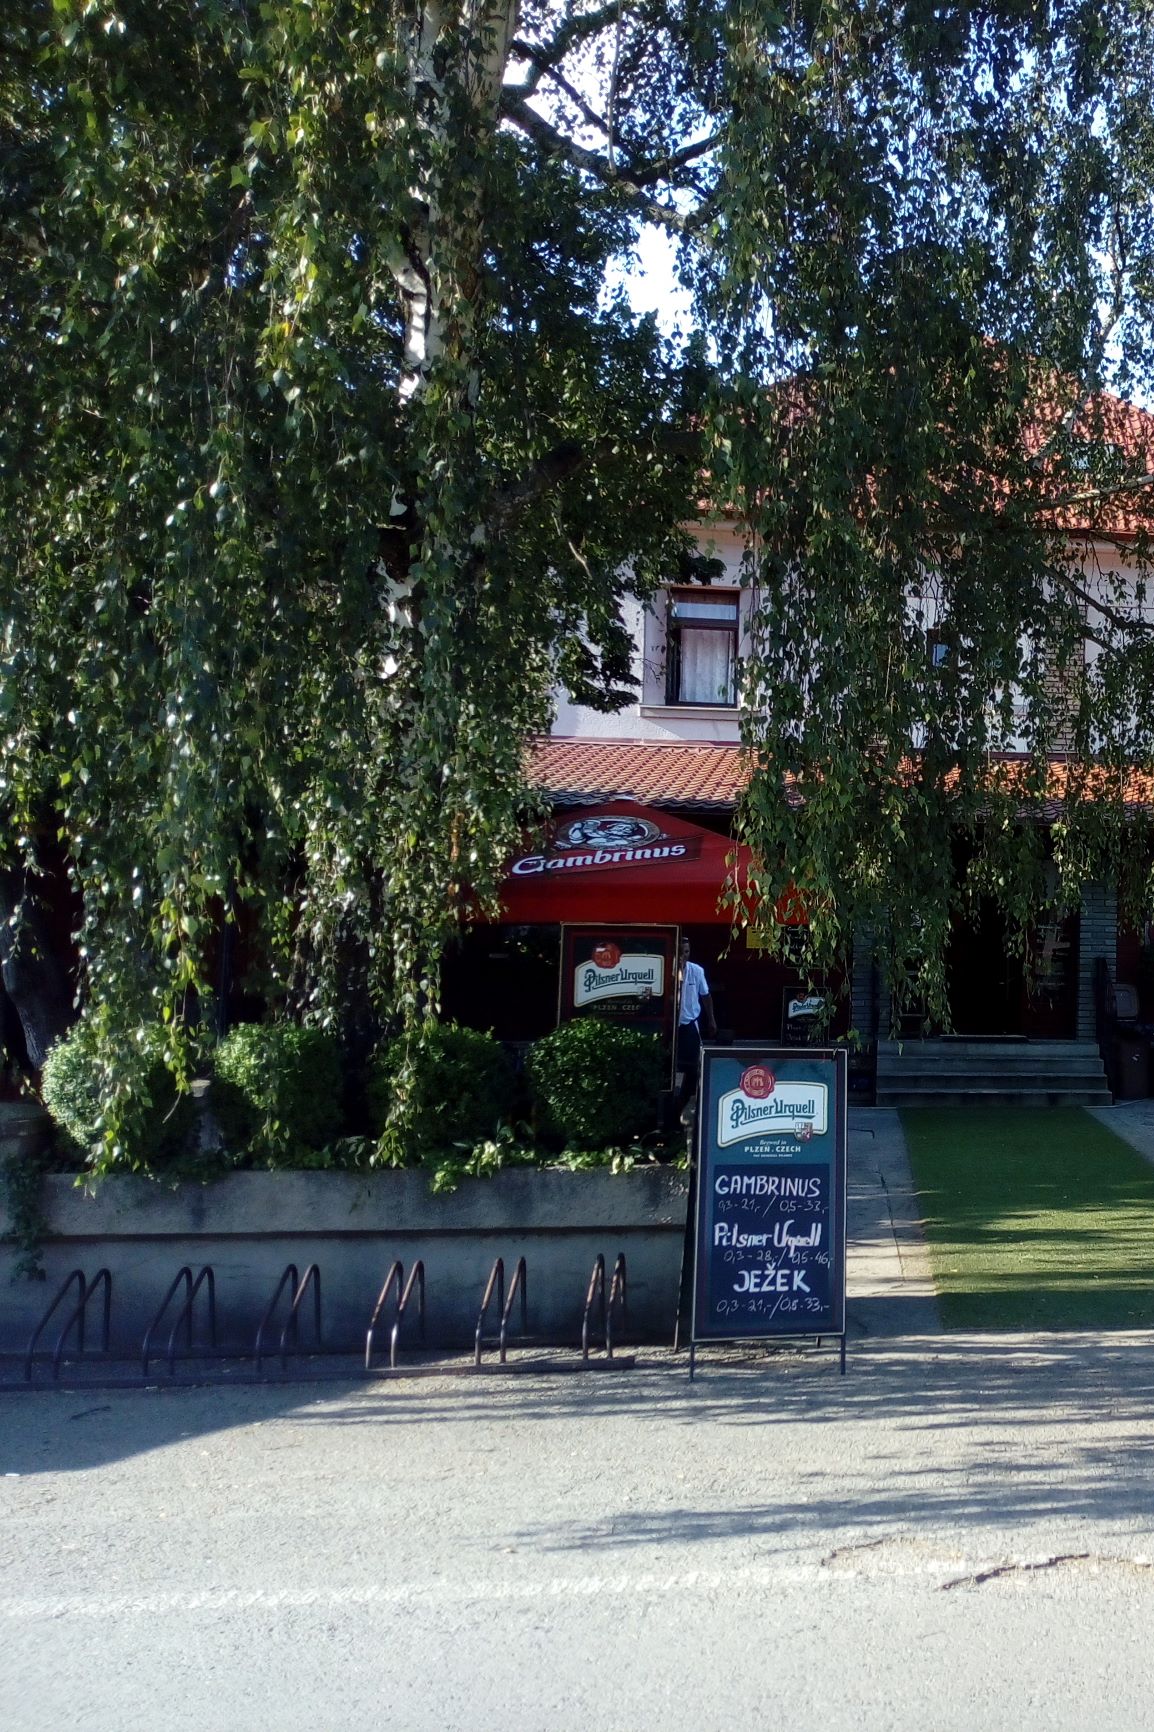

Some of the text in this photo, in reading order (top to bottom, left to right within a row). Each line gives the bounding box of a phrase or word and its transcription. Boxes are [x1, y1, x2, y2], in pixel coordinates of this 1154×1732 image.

[511, 843, 687, 875] Gambrinus
[583, 967, 654, 993] Pilsner Urquell
[730, 1098, 815, 1129] Pilsner Urquell
[775, 1145, 801, 1153] CZECH
[715, 1175, 821, 1198] GAMBRINUS
[714, 1220, 822, 1258] Pilsner Urquell
[733, 1262, 811, 1293] JEŽEK
